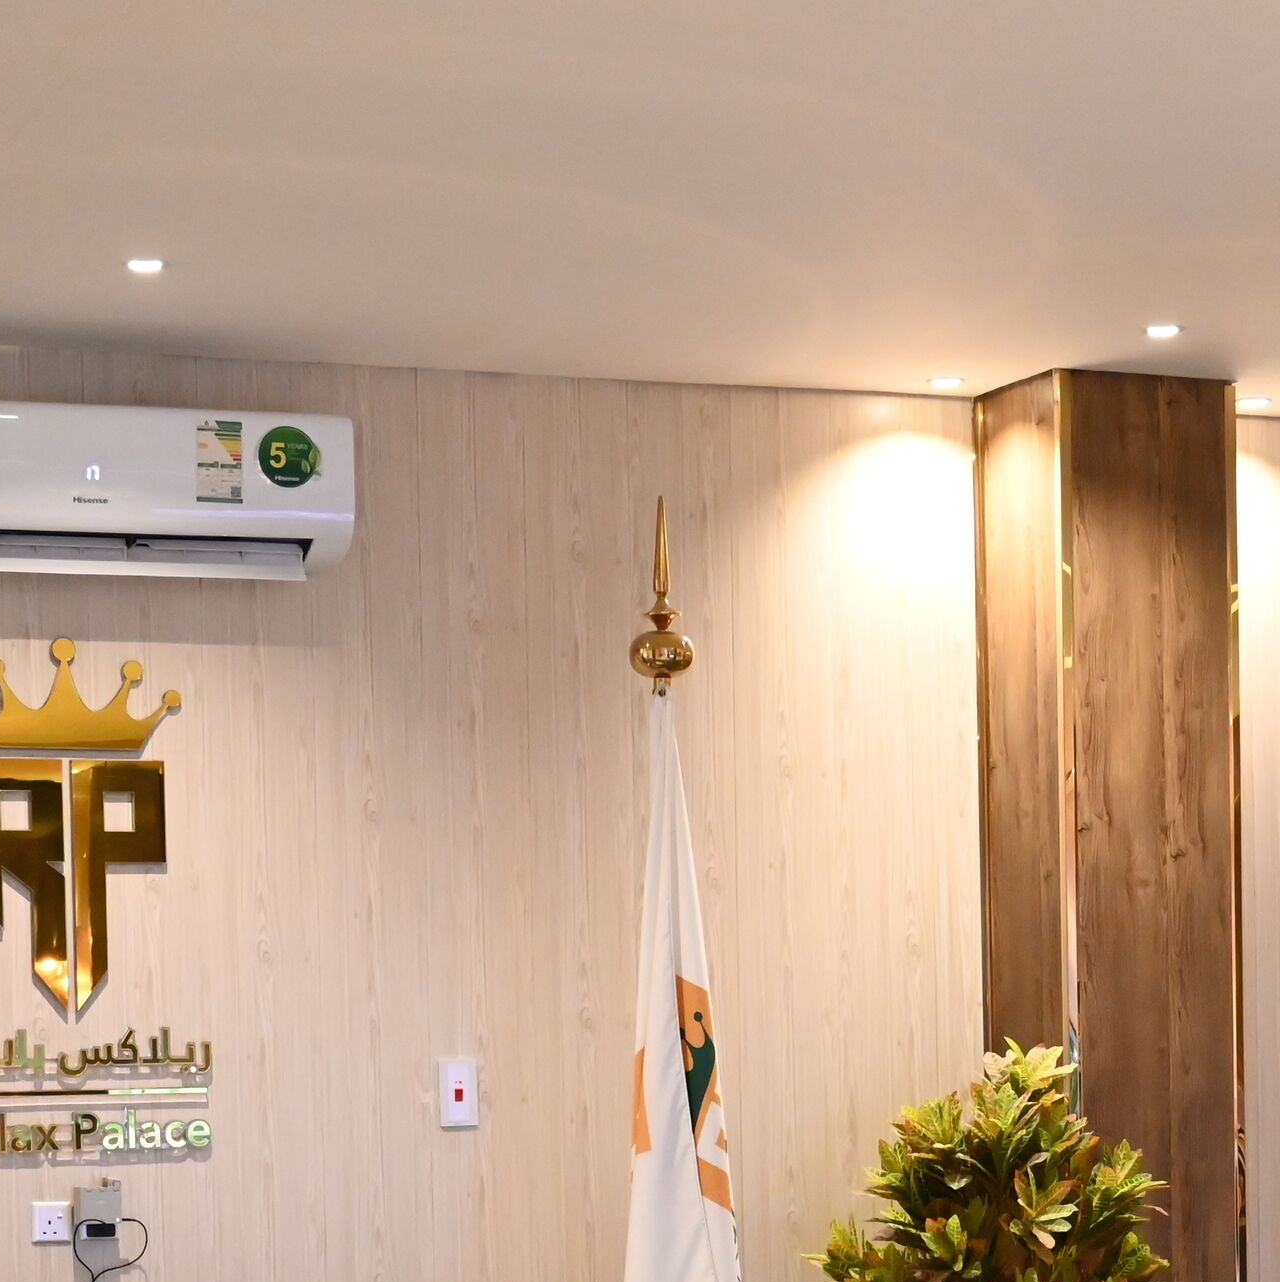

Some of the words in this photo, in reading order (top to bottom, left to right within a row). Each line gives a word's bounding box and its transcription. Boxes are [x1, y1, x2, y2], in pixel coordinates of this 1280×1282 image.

[269, 441, 287, 469] 5
[72, 496, 109, 504] Hisense
[72, 1108, 211, 1152] Palace
